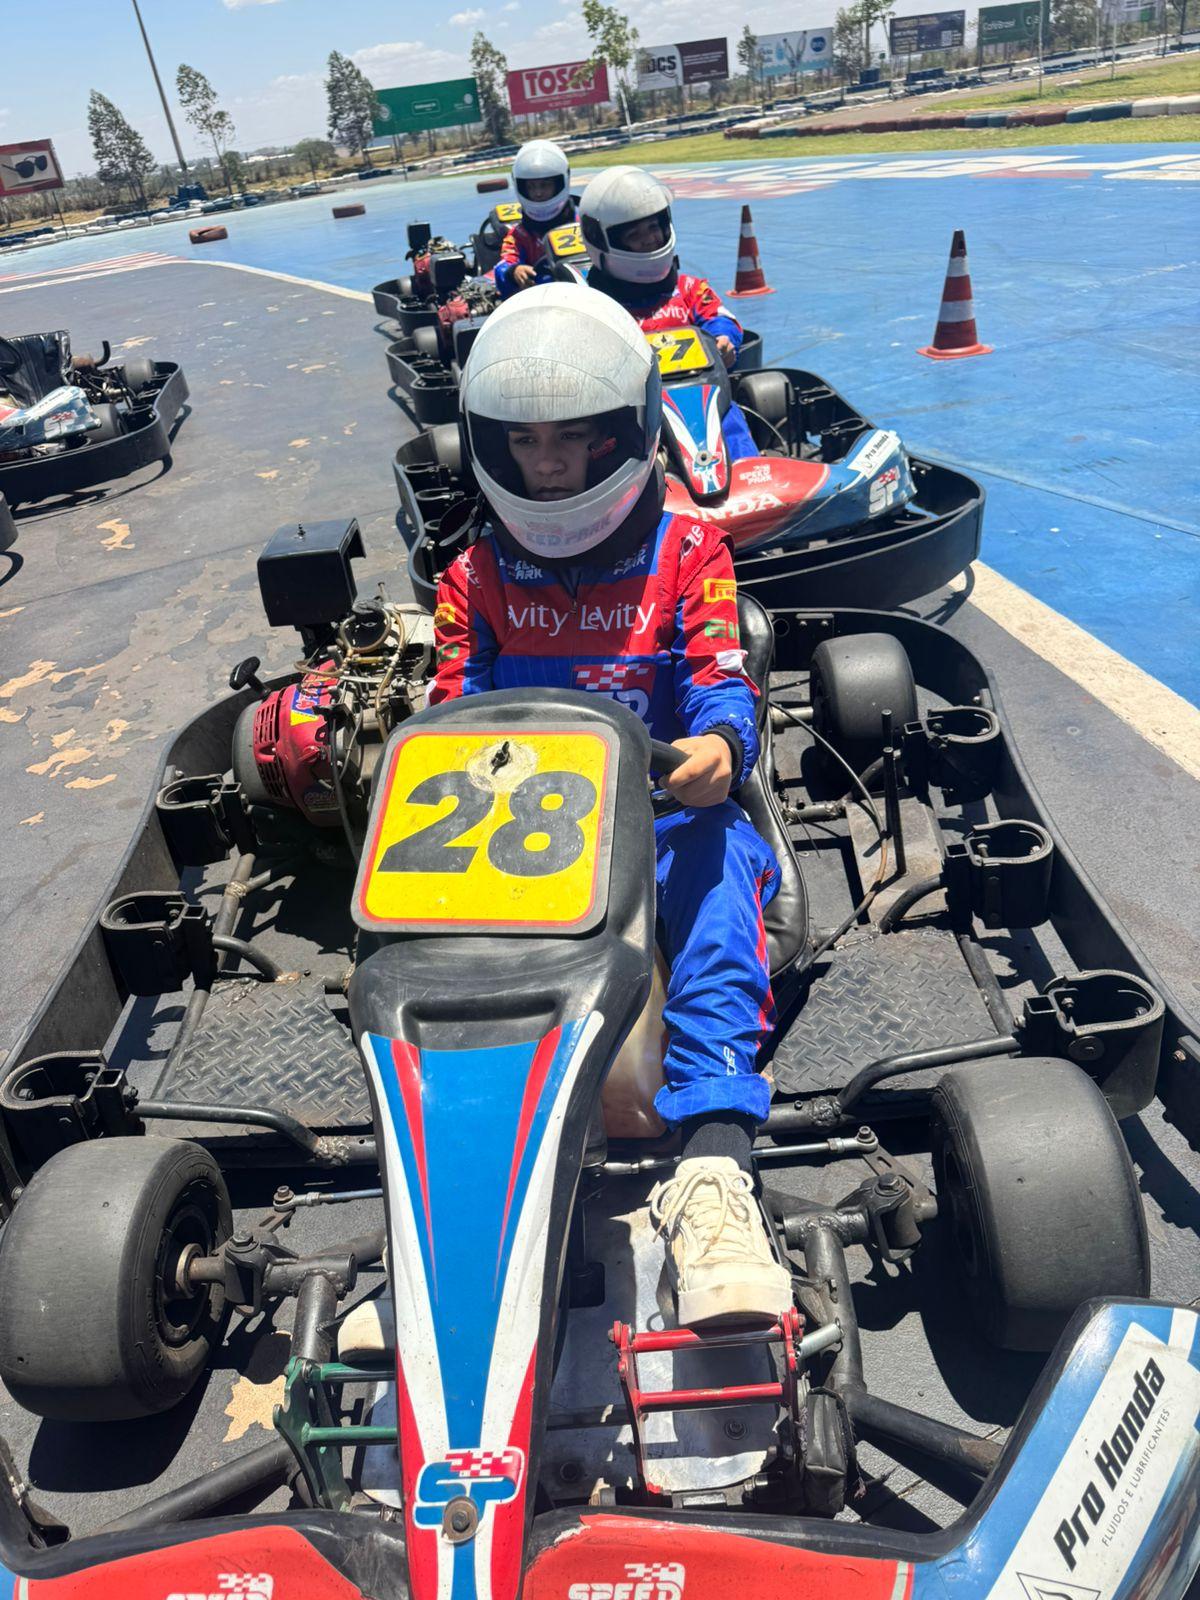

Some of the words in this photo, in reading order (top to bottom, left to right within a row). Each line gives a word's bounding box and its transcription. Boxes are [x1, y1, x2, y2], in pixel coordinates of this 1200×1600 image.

[377, 770, 598, 877] 28
[1053, 1481, 1106, 1572] Pro
[1094, 1357, 1166, 1492] Honda
[1102, 1498, 1131, 1547] FLUIDOS
[1126, 1489, 1135, 1498] E
[1132, 1409, 1170, 1489] LUBRIFICANTES
